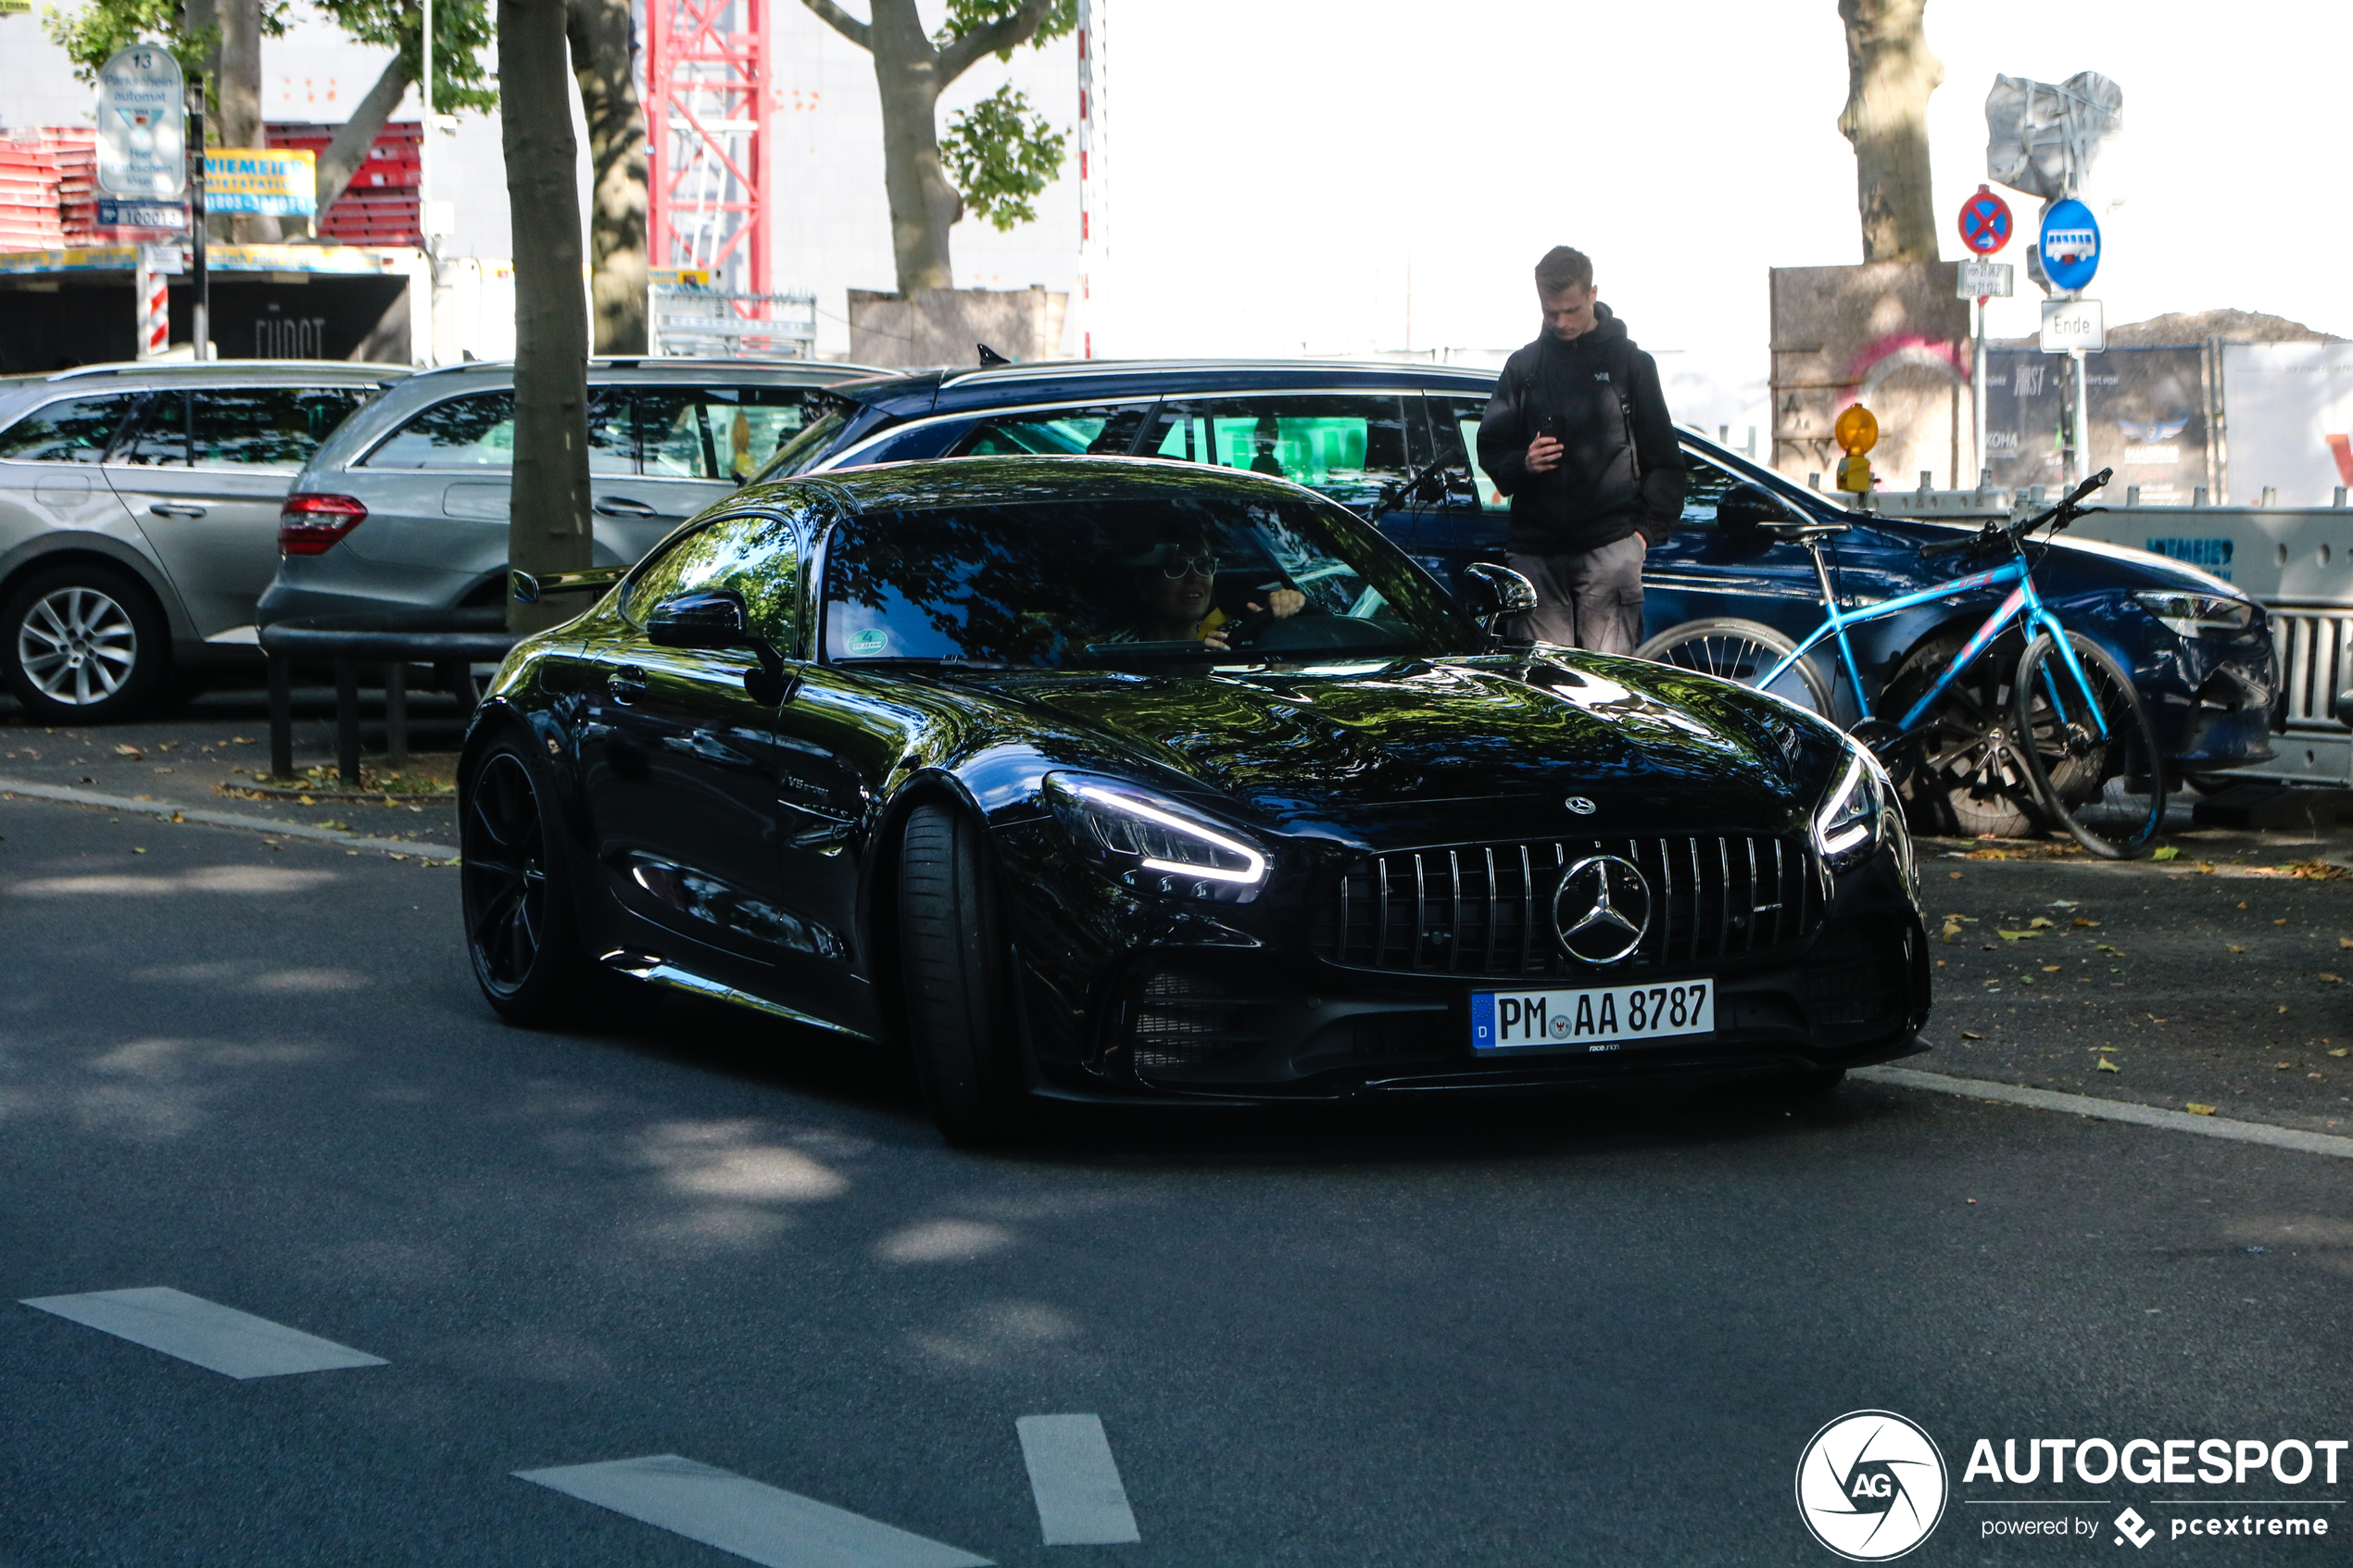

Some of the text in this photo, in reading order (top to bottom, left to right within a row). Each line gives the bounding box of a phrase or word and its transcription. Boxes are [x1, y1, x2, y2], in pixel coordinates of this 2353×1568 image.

[133, 53, 152, 69] 13
[114, 92, 166, 103] automat
[130, 148, 152, 158] Hier
[111, 163, 172, 173] Parkschein
[2054, 315, 2090, 334] Ende
[862, 631, 873, 643] 4
[1499, 984, 1706, 1040] PM AA 8787
[1478, 1025, 1488, 1038] D
